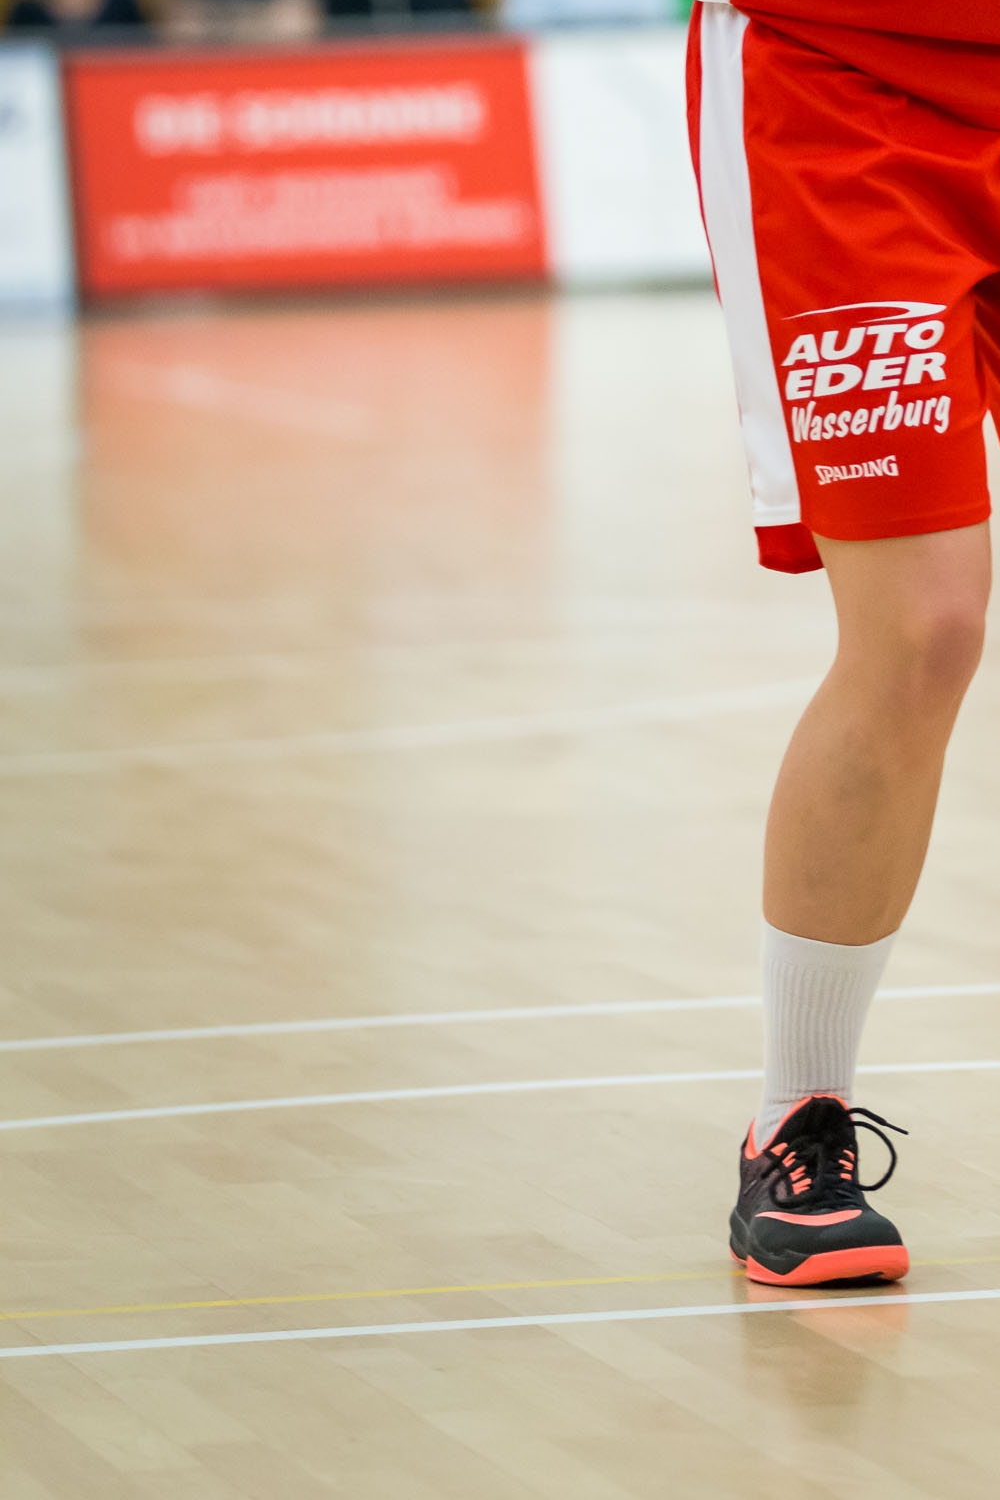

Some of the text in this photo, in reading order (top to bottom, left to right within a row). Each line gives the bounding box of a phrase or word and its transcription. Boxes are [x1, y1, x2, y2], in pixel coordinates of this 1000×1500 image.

[781, 320, 945, 367] AUTO
[784, 352, 947, 401] EDER
[791, 390, 952, 444] Wasserburg
[814, 455, 899, 486] SPALDING
